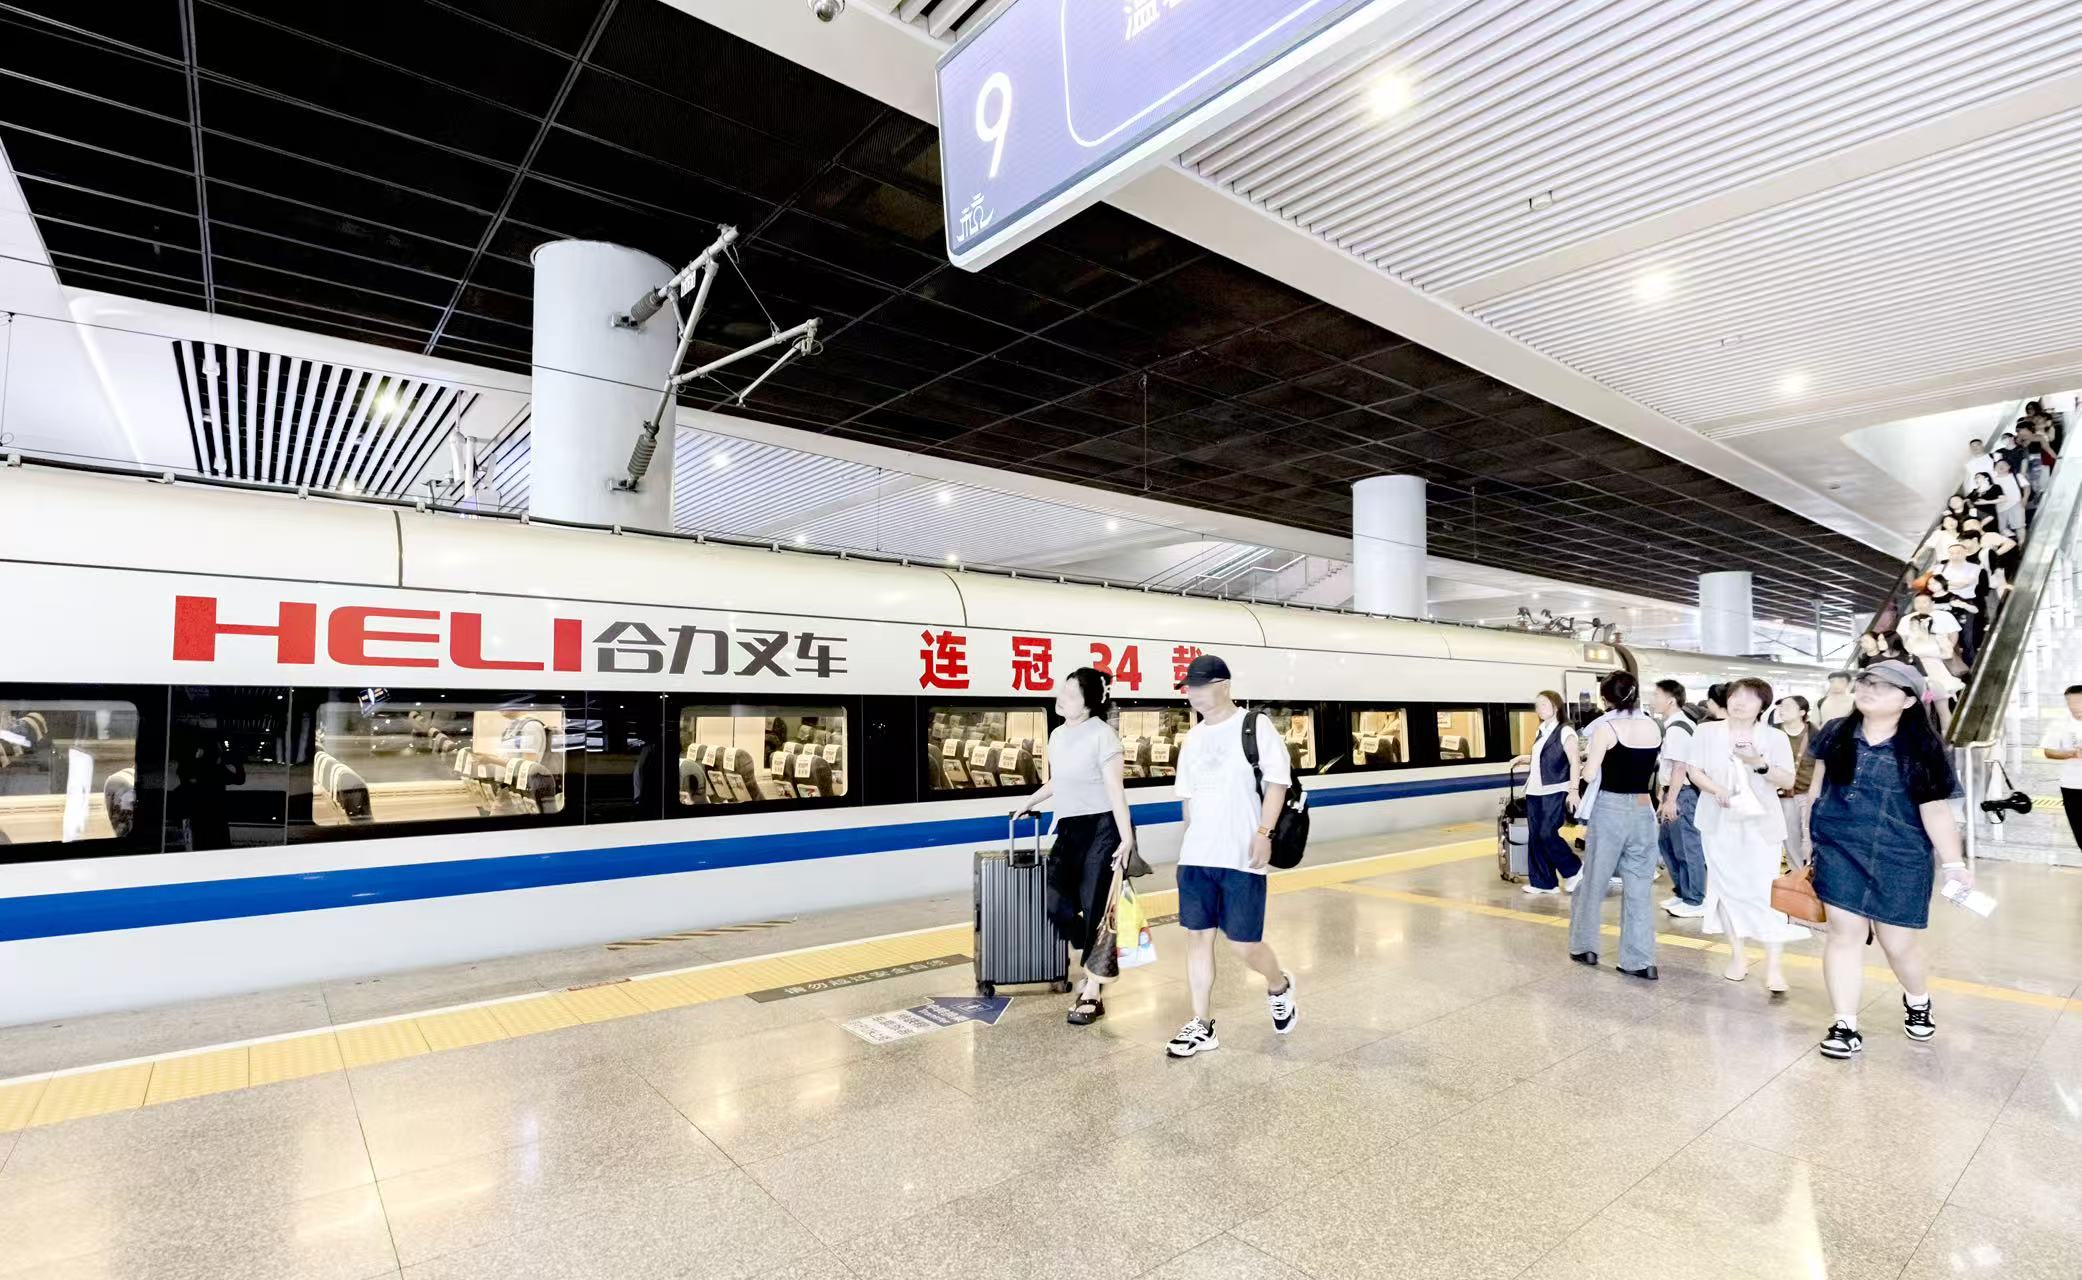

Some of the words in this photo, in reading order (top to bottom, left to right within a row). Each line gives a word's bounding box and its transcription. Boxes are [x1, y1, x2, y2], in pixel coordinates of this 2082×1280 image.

[976, 72, 1012, 179] 9
[173, 595, 582, 672] HELI
[592, 621, 848, 678] 合力叉车
